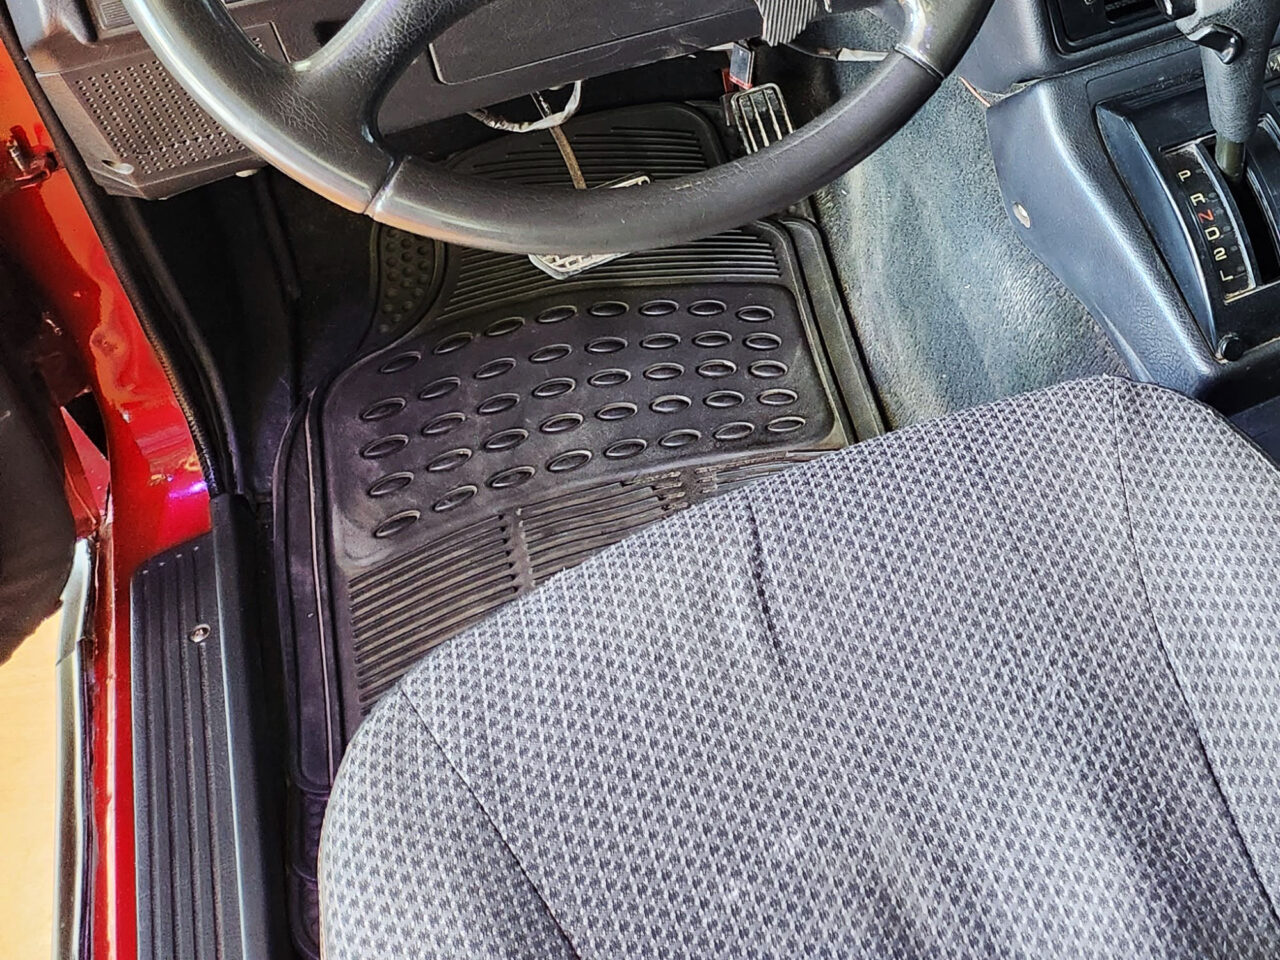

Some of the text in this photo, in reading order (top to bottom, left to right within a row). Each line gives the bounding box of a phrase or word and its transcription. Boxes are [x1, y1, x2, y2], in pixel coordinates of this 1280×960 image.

[1178, 169, 1192, 183] P
[1190, 192, 1206, 207] R
[1204, 226, 1220, 241] D
[1213, 247, 1227, 261] 2
[1220, 269, 1234, 282] L
